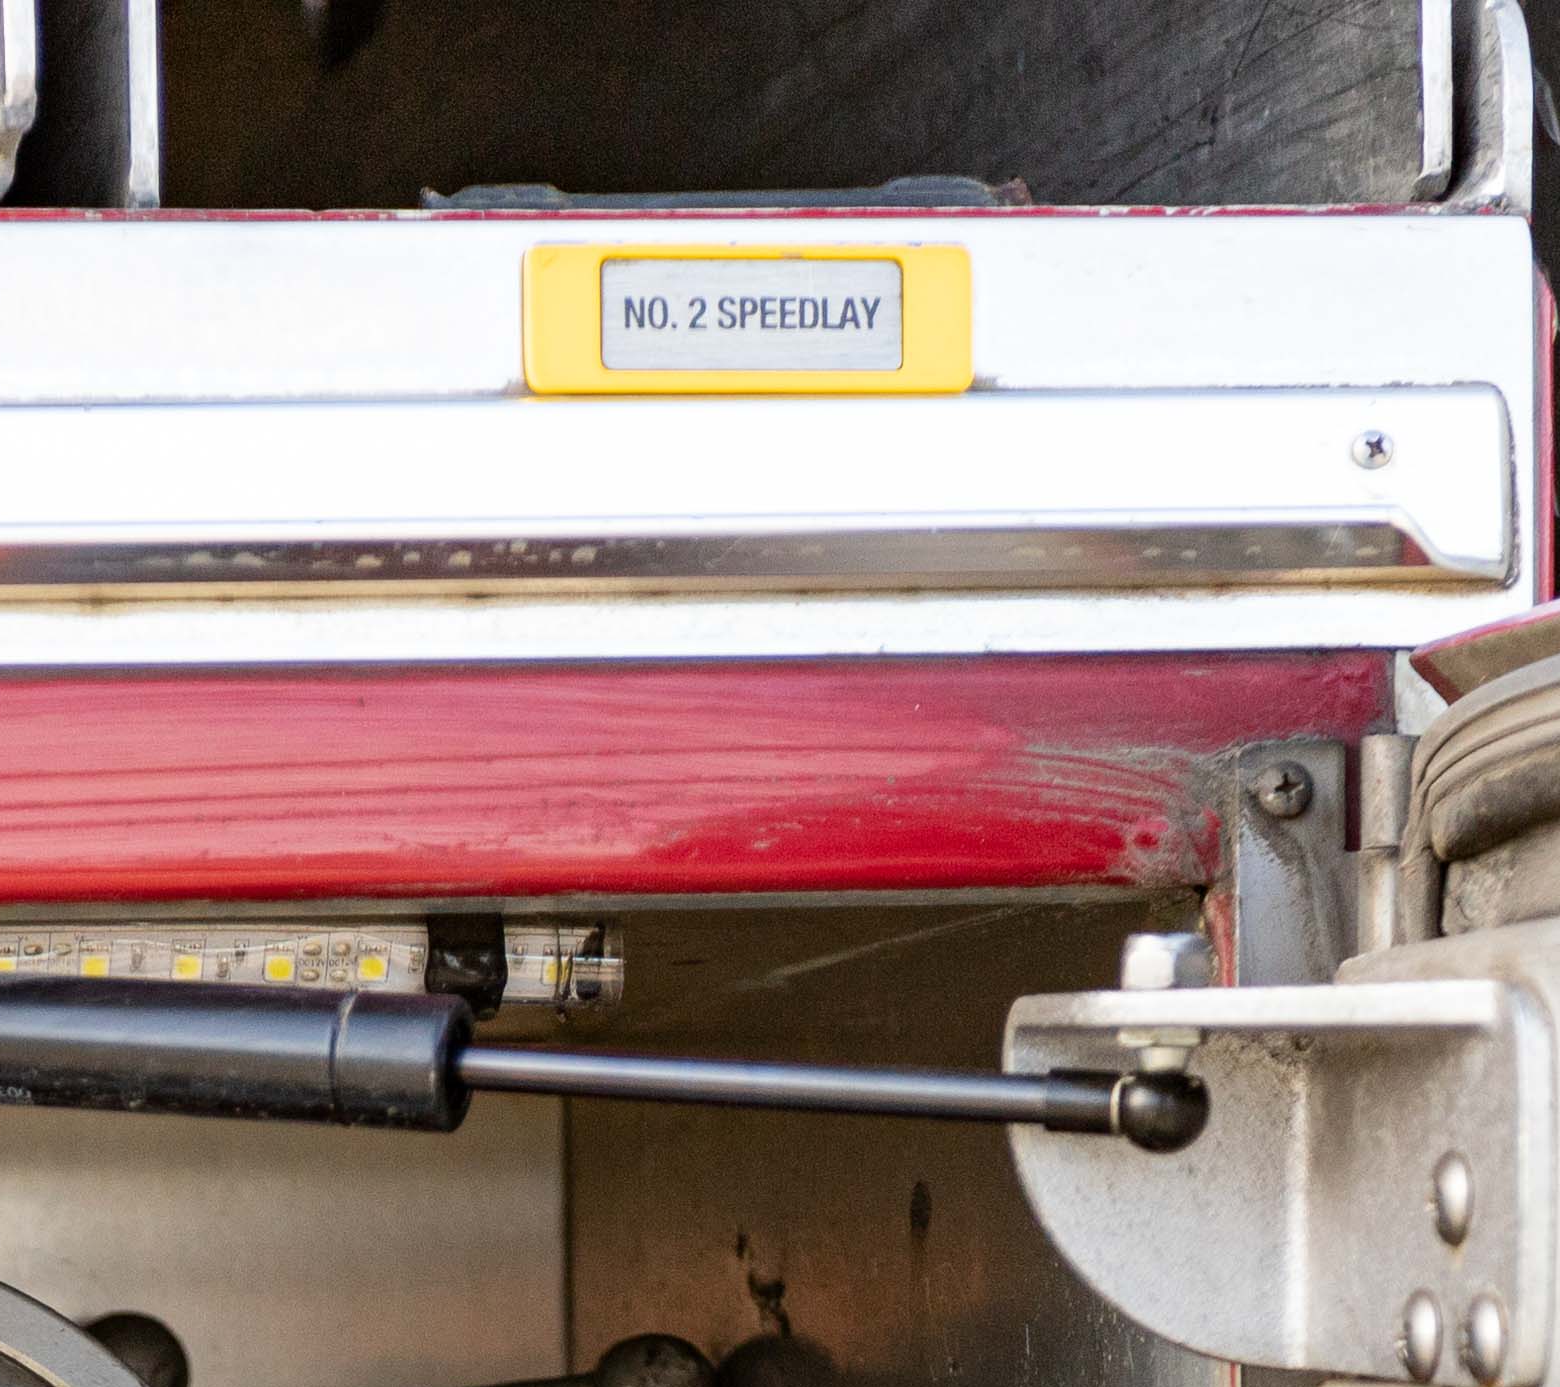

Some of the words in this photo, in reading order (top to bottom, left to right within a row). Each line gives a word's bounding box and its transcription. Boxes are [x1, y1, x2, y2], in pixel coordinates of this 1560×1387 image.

[624, 296, 678, 330] NO.
[688, 296, 708, 329] 2
[717, 295, 882, 330] SPEEDLAY
